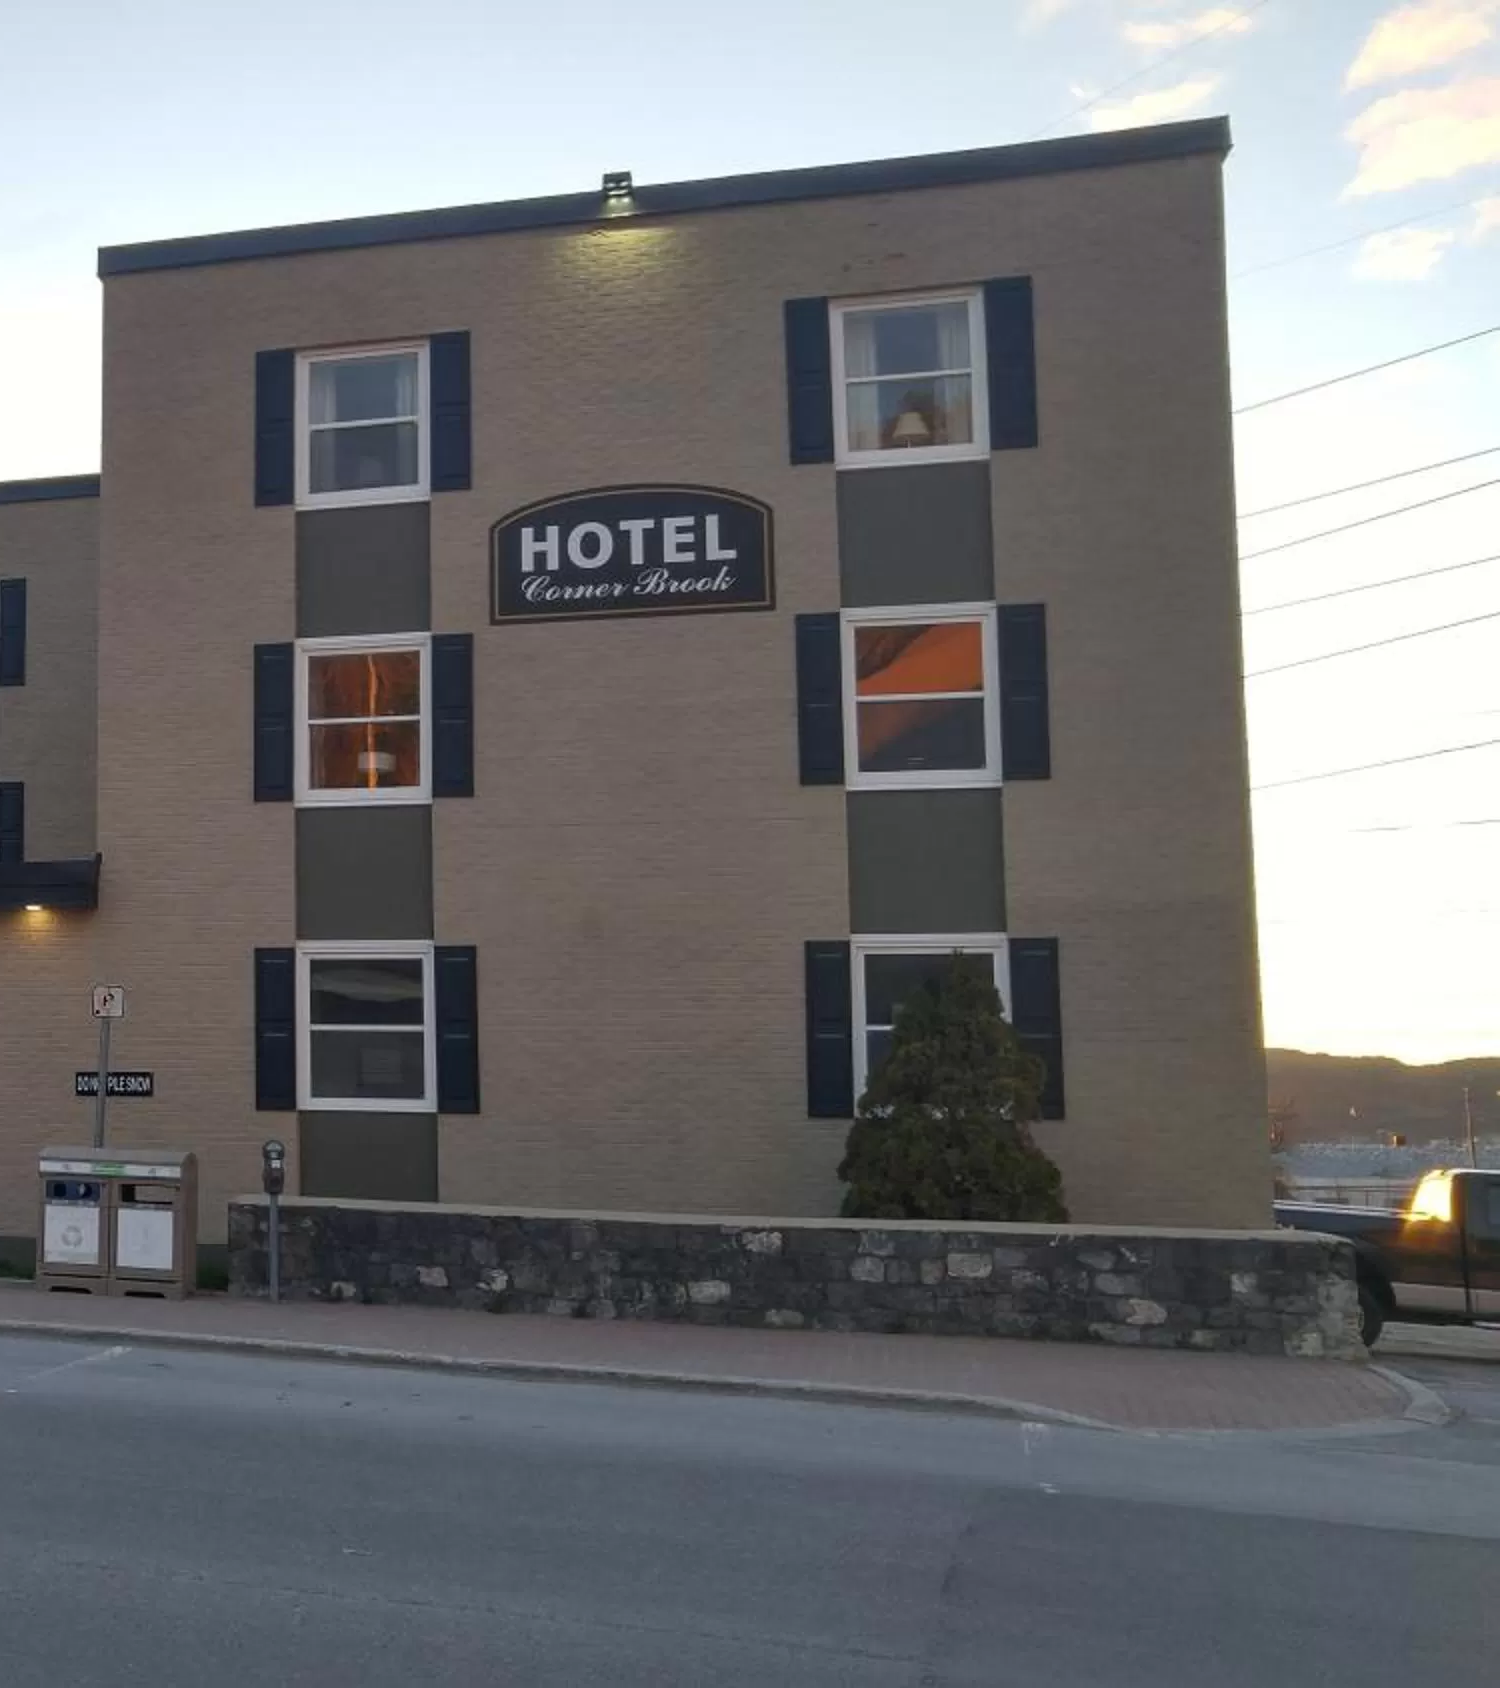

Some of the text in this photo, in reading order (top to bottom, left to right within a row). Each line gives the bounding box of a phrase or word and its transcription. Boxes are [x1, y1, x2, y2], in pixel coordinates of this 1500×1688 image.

[520, 514, 738, 573] HOTEL
[521, 566, 738, 603] Corner Brook
